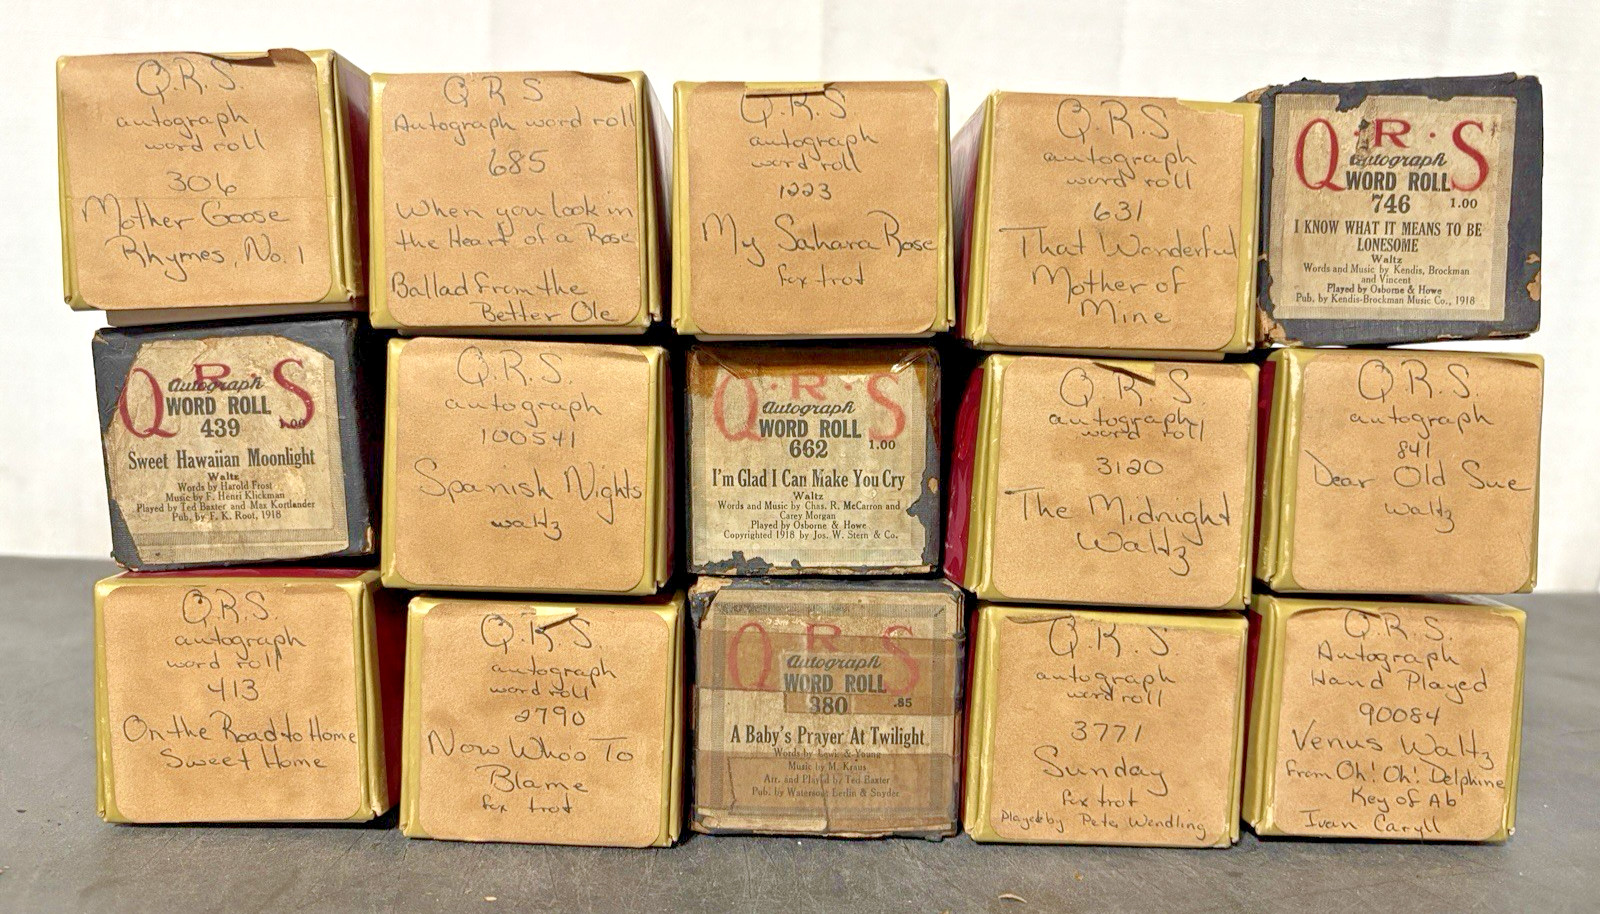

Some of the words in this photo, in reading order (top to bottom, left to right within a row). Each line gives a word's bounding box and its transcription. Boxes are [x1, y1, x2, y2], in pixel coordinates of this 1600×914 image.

[117, 101, 249, 139] autograph
[393, 112, 515, 146] Autograph
[526, 107, 582, 128] word
[593, 104, 636, 127] roll
[145, 134, 203, 152] word
[214, 129, 266, 151] roll
[750, 124, 878, 161] autograph
[488, 149, 548, 176] 685
[1043, 139, 1196, 180] autograph
[167, 171, 237, 196] 306
[780, 182, 832, 200] 1223
[1346, 171, 1397, 191] WORD
[1408, 172, 1451, 192] ROLL
[81, 194, 194, 235] Mother
[201, 200, 290, 227] Goose
[396, 199, 482, 219] When
[496, 204, 542, 237] you
[551, 192, 599, 217] look
[607, 191, 634, 217] in
[1094, 201, 1143, 222] 631
[1372, 194, 1411, 214] 746
[1450, 198, 1478, 209] 1.00
[395, 229, 439, 251] the
[449, 222, 507, 248] Heart
[524, 223, 545, 245] of
[556, 231, 573, 243] a
[575, 222, 635, 246] Rose
[702, 212, 765, 267] My
[775, 213, 881, 251] Sahara
[867, 210, 937, 257] Rose
[1294, 220, 1299, 234] I
[1304, 220, 1339, 234] KNOW
[1345, 221, 1379, 235] WHAT
[1384, 221, 1395, 235] IT
[1402, 222, 1441, 236] MEANS
[1446, 223, 1461, 236] TO
[1467, 223, 1482, 237] BE
[999, 226, 1086, 258] That
[1100, 225, 1238, 259] Wonderful
[1357, 238, 1419, 252] LONESOME
[105, 235, 238, 282] Rhymes,
[244, 233, 286, 263] No.
[298, 246, 304, 264] 1
[1371, 254, 1403, 264] Waltz
[391, 271, 467, 298] Ballad
[474, 272, 532, 296] from
[537, 269, 588, 295] the
[778, 263, 807, 288] fox
[817, 262, 865, 287] trot
[1032, 265, 1146, 304] Mother
[1156, 266, 1187, 294] of
[470, 301, 561, 322] Better
[571, 301, 619, 322] Ole
[1080, 299, 1171, 324] Mine
[1295, 293, 1315, 303] Pub.
[1318, 294, 1328, 304] by
[1331, 294, 1404, 304] Kendis-Brockman
[1407, 295, 1430, 305] Music
[1455, 296, 1475, 305] 1918
[457, 345, 573, 387] Q.R.S.
[1358, 359, 1479, 403] Q.R.S.
[166, 397, 217, 416] WORD
[229, 396, 272, 415] ROLL
[445, 392, 602, 427] autograph
[200, 418, 241, 437] 439
[759, 419, 809, 438] WORD
[819, 419, 862, 438] ROLL
[1350, 403, 1493, 439] autograph
[482, 429, 575, 448] 100541
[789, 440, 828, 458] 662
[869, 440, 896, 449] 1.00
[1397, 440, 1430, 459] 841
[128, 451, 168, 470] Sweet
[176, 450, 241, 468] Hawaiian
[248, 447, 315, 468] Moonlight
[1096, 457, 1163, 475] 3120
[1304, 449, 1376, 489] Dear
[1393, 460, 1446, 488] Old
[1461, 460, 1531, 491] Sue
[207, 472, 239, 481] Waltz
[712, 468, 734, 487] I'm
[738, 469, 767, 487] Glad
[772, 469, 777, 487] I
[782, 469, 807, 487] Can
[812, 469, 848, 487] Make
[853, 470, 879, 487] You
[882, 470, 905, 490] Cry
[414, 457, 553, 504] Spanish
[564, 461, 643, 525] Nights
[793, 491, 824, 500] Waltz
[136, 503, 165, 513] Played
[168, 503, 178, 513] by
[181, 503, 197, 511] Ted
[200, 502, 227, 511] Baxter
[230, 502, 246, 510] and
[250, 502, 269, 510] Max
[271, 500, 315, 509] Kortlander
[718, 502, 744, 510] Words
[747, 502, 762, 510] and
[764, 502, 788, 510] Music
[791, 502, 801, 511] by
[804, 502, 827, 510] Chas.
[830, 502, 840, 510] R.
[843, 502, 883, 510] McCarron
[886, 502, 900, 510] and
[1004, 486, 1073, 520] The
[1088, 491, 1231, 546] Midnight
[491, 507, 562, 541] waltz
[1076, 527, 1190, 577] Waltz
[174, 625, 306, 660] autograph
[1317, 640, 1459, 672] Autograph
[208, 677, 259, 702] 413
[784, 674, 833, 693] WORD
[845, 674, 887, 693] ROLL
[1311, 669, 1384, 689] Hand
[1397, 668, 1487, 704] Played
[514, 706, 585, 726] 2790
[809, 696, 848, 715] 380
[893, 698, 913, 708] .85
[1359, 703, 1440, 726] 90084
[123, 714, 165, 742] On
[167, 715, 211, 740] the
[210, 711, 277, 744] Road
[280, 713, 303, 742] to
[309, 716, 357, 743] Home
[730, 725, 741, 743] A
[746, 725, 791, 746] Baby's
[799, 726, 844, 747] Prayer
[850, 727, 864, 745] At
[871, 727, 925, 747] Twilight
[1071, 721, 1142, 743] 3771
[1292, 719, 1383, 750] Venus
[1401, 730, 1495, 770] Waltz
[160, 748, 251, 770] Sweet
[261, 746, 328, 769] Home
[475, 764, 588, 793] Blame
[1034, 745, 1168, 797] Sunday
[1286, 759, 1332, 780] from
[1336, 760, 1376, 783] Oh!
[1383, 766, 1419, 784] Oh!
[1419, 757, 1505, 795] Delphine
[1351, 788, 1390, 812] Key
[1396, 789, 1420, 805] of
[1299, 809, 1357, 830] Ivan
[1374, 814, 1441, 837] Caryll
